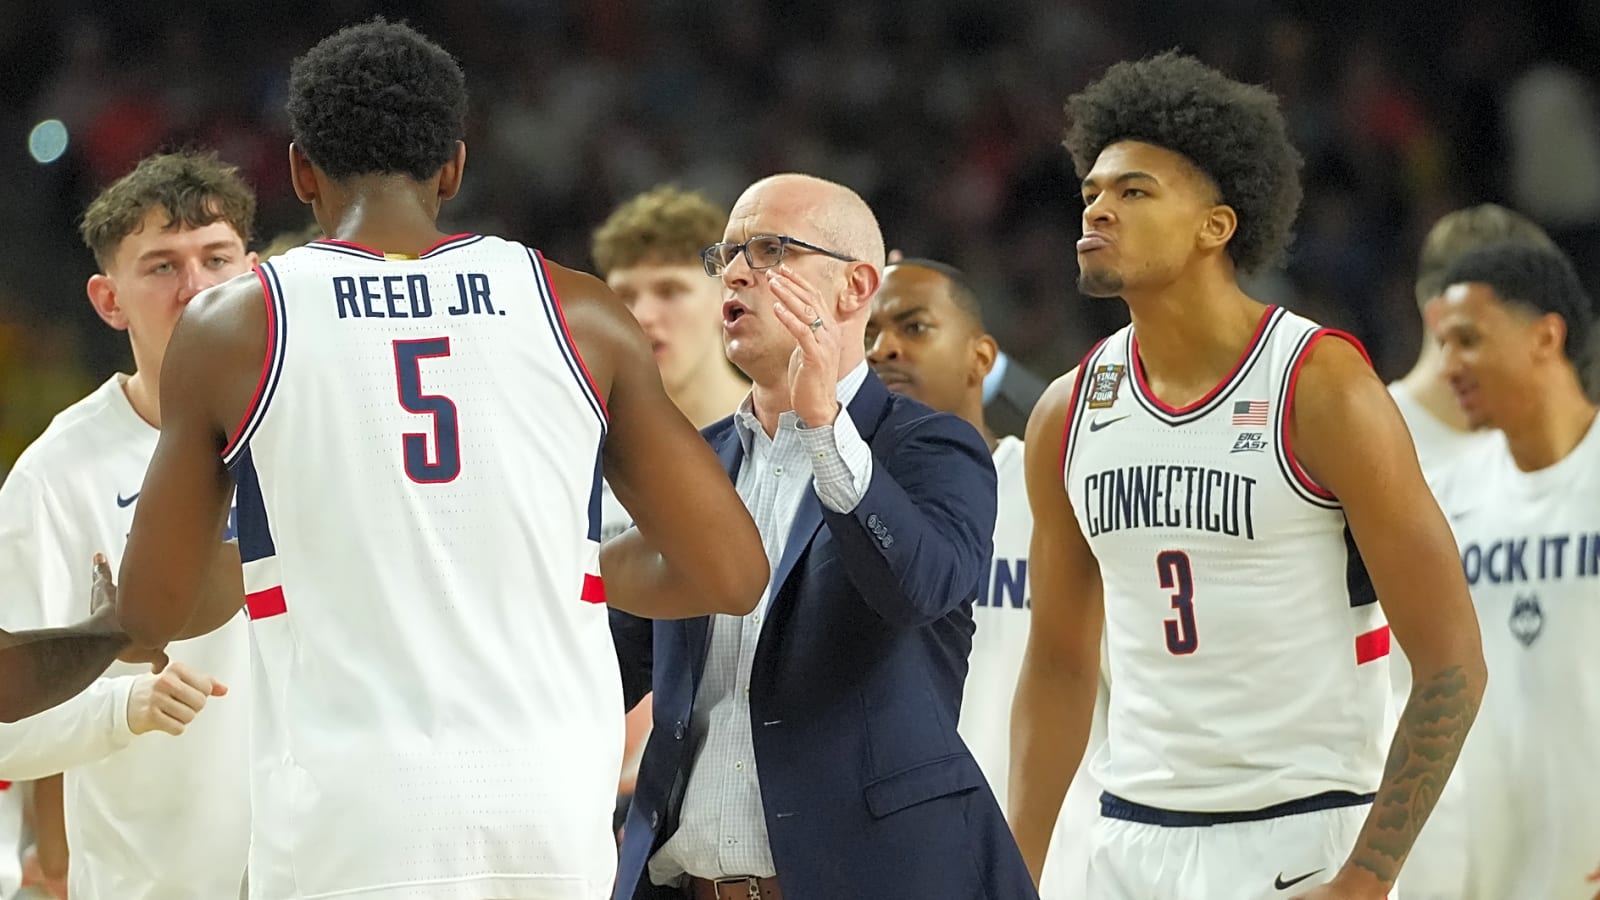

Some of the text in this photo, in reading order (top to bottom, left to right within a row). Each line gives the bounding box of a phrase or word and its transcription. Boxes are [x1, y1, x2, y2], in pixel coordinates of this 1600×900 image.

[333, 273, 506, 319] REED JR.
[1092, 391, 1114, 401] FOUR
[1096, 371, 1118, 382] FINAL
[392, 336, 461, 484] 5
[1233, 440, 1269, 449] EAST
[1238, 432, 1263, 441] BIG
[1085, 464, 1257, 540] CONNECTICUT
[1462, 539, 1528, 586] OCK
[1539, 535, 1570, 580] IT
[1156, 549, 1198, 656] 3
